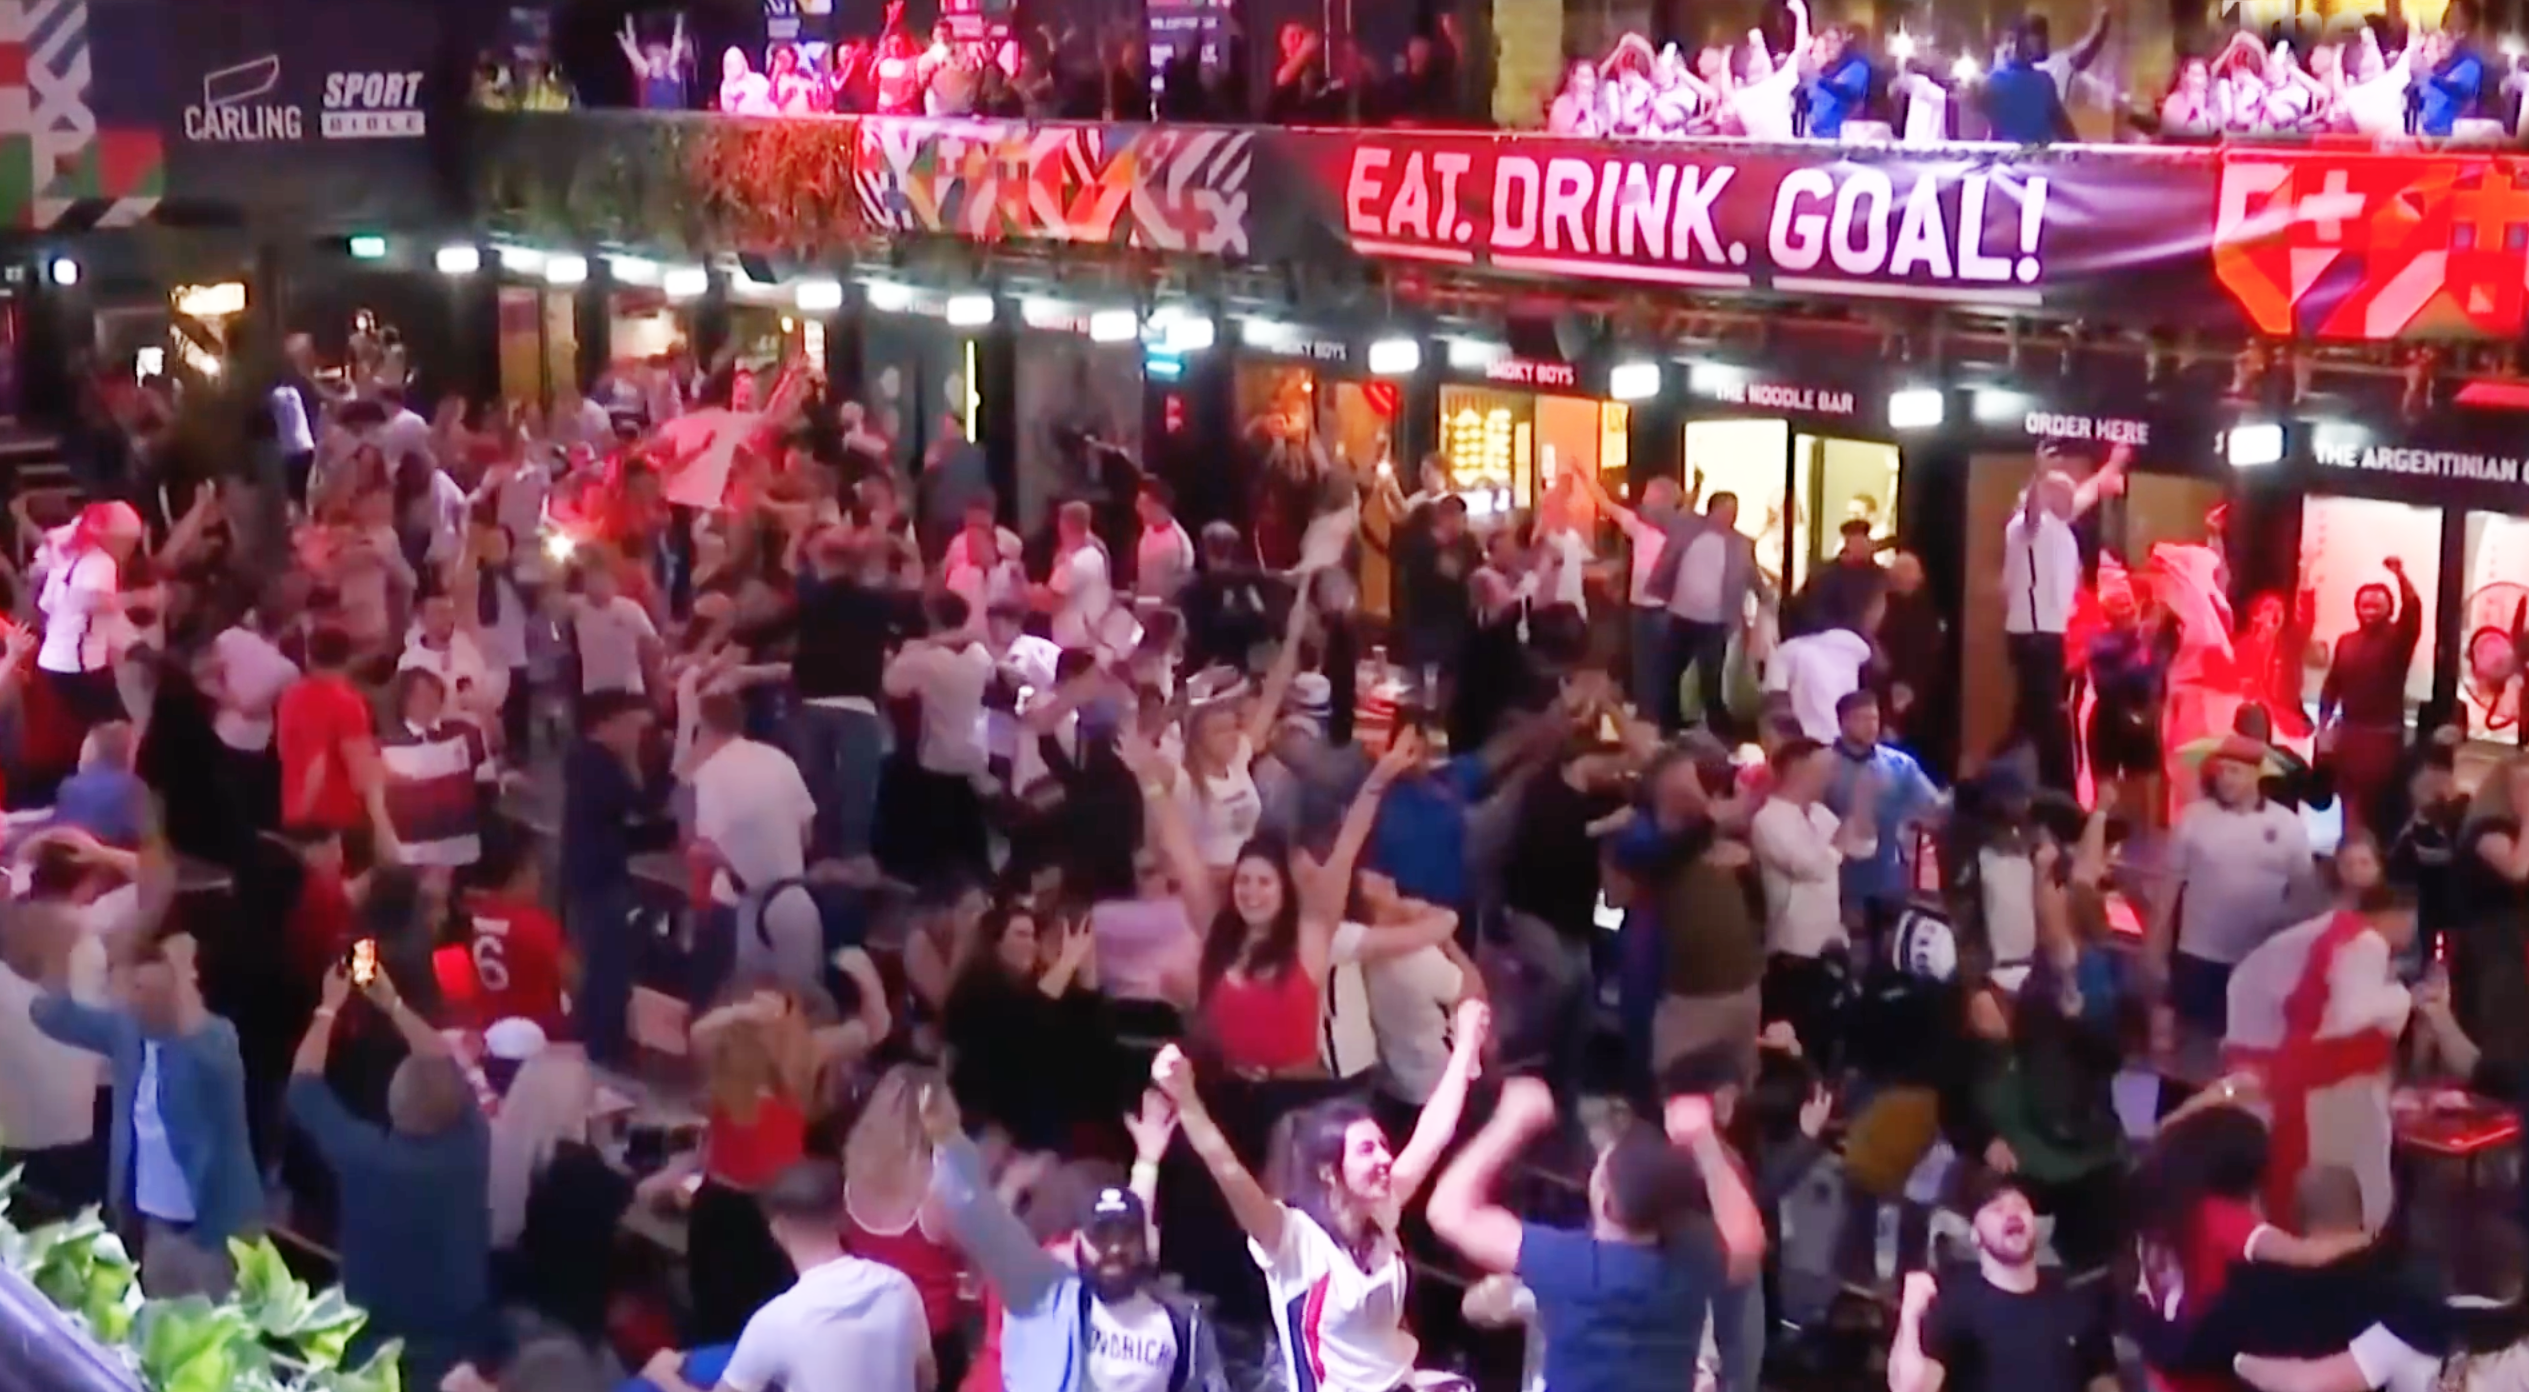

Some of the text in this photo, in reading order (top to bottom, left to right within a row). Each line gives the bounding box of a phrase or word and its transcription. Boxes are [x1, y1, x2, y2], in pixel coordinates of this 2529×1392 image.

[324, 71, 424, 107] SPORT
[184, 104, 302, 141] CARLING
[1347, 147, 2048, 283] EAT. DRINK. GOAL!
[1537, 365, 1575, 387] BOYS
[1748, 384, 1814, 411] NOODLE
[1818, 391, 1854, 414] BAR
[2025, 411, 2150, 446] ORDER HERE
[2315, 441, 2357, 467] THE
[2361, 447, 2518, 482] ARGENTINIAN
